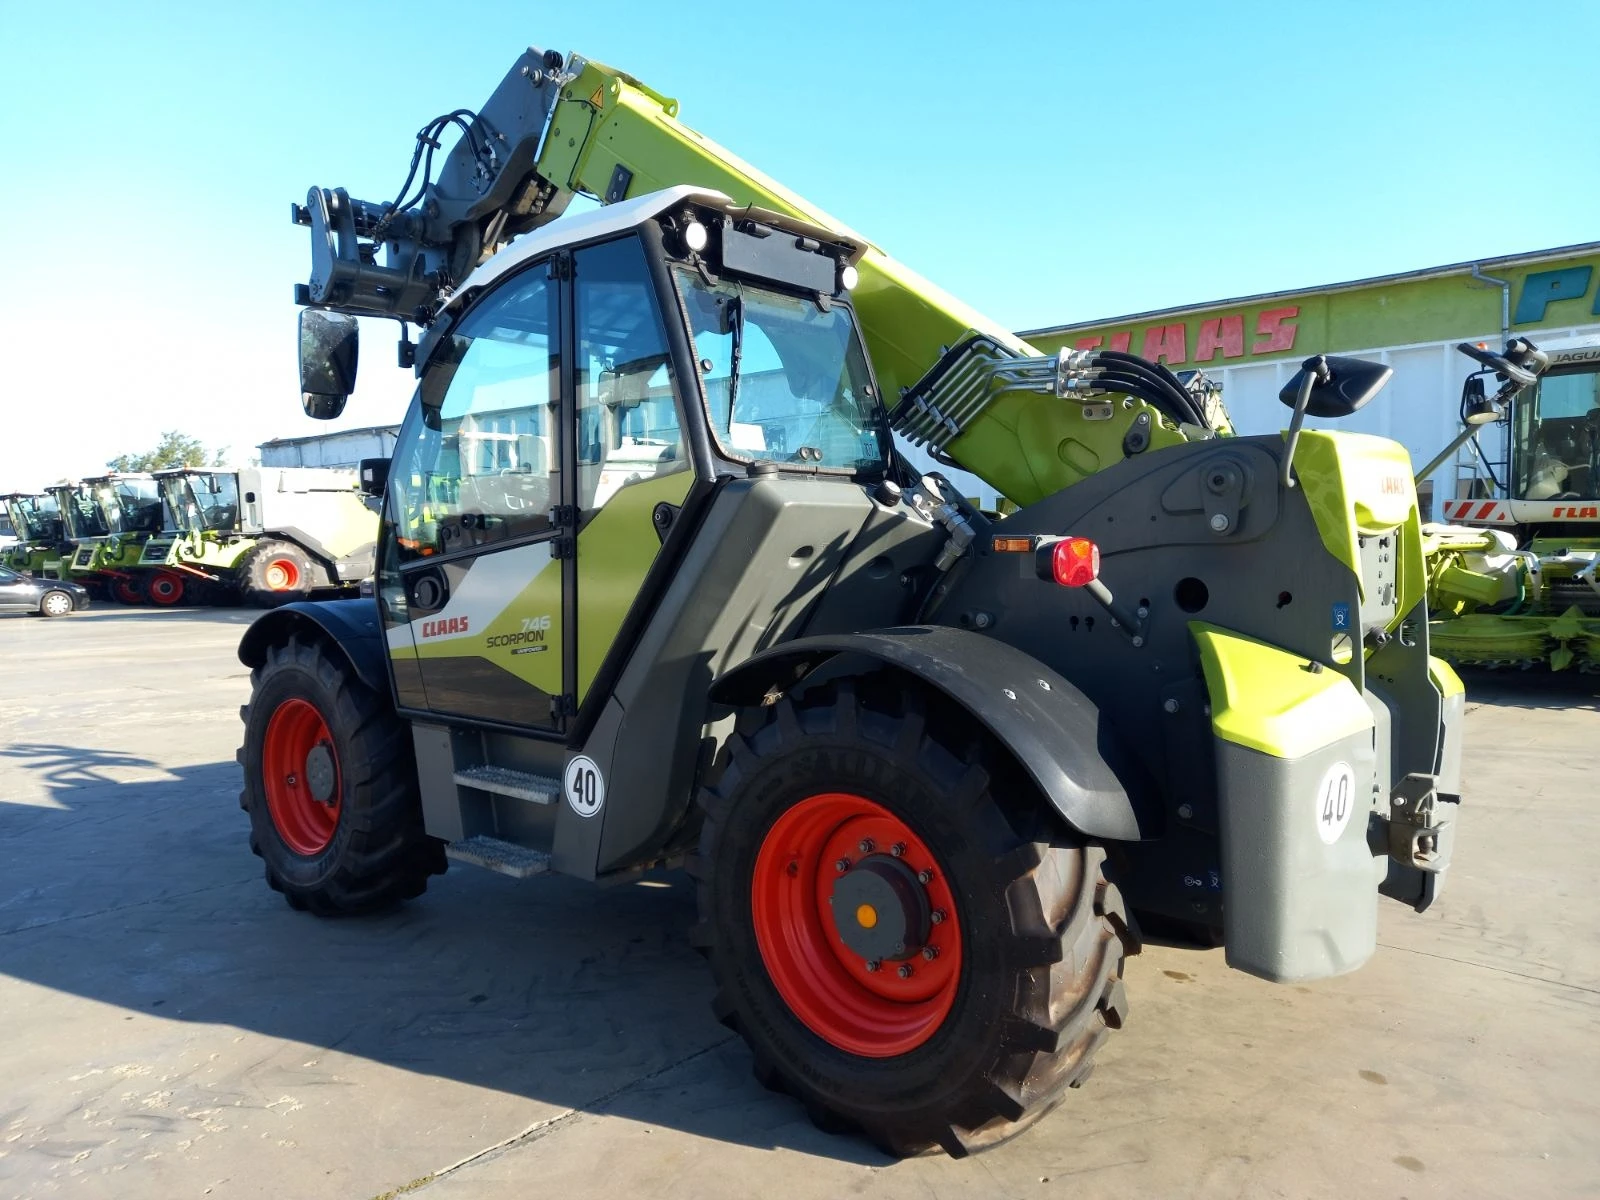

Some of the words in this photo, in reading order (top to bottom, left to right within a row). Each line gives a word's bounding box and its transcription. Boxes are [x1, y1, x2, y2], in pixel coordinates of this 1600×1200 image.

[1513, 265, 1600, 325] P
[423, 616, 468, 637] CLAAS
[487, 630, 544, 648] SCORPION
[521, 615, 551, 633] 746
[573, 767, 595, 806] 40
[1322, 774, 1348, 825] 40
